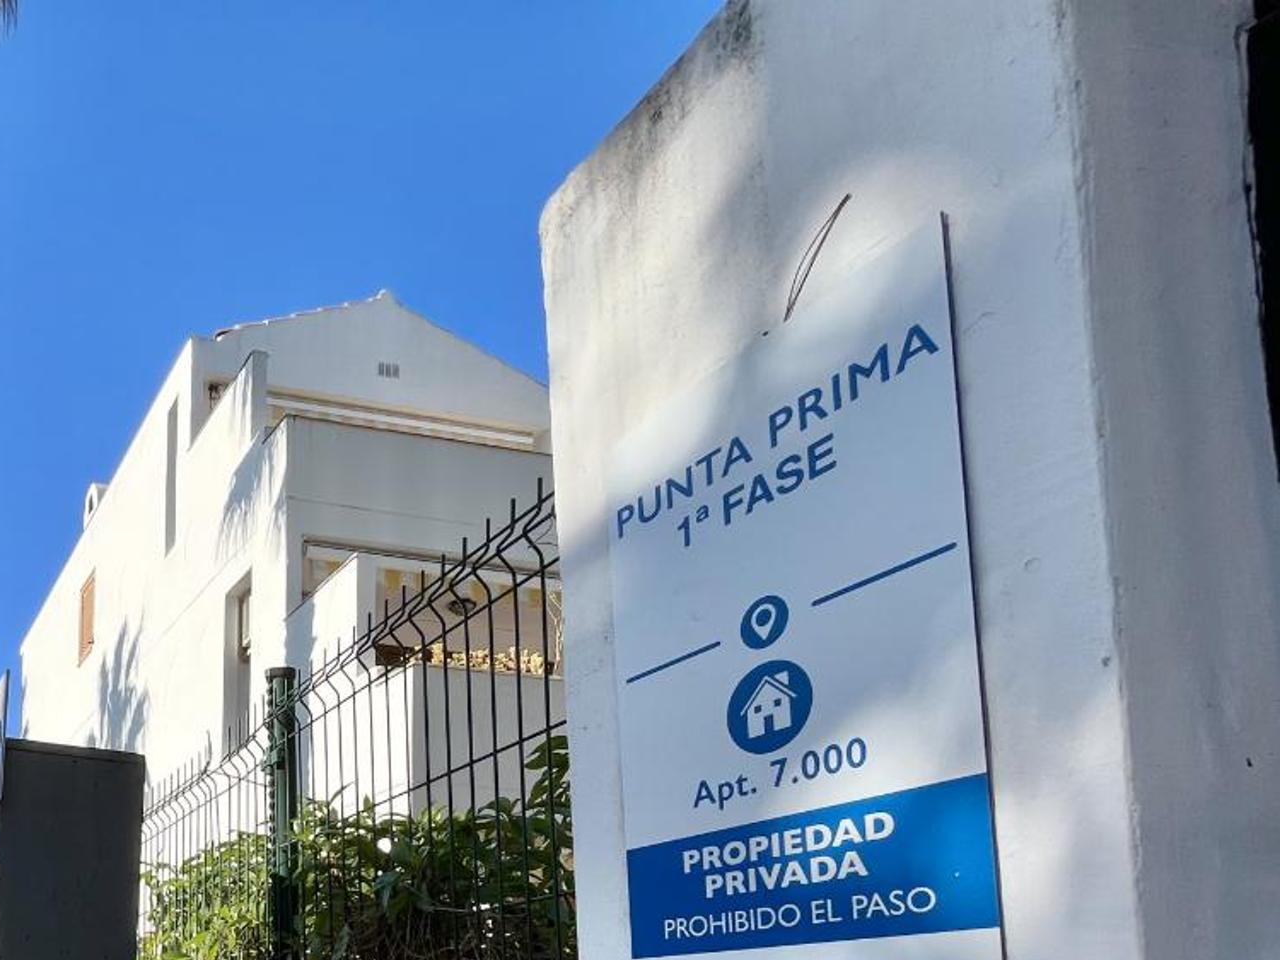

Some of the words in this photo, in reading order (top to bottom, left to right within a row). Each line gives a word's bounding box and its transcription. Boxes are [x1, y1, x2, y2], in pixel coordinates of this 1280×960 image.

[616, 436, 753, 539] PUNTA
[768, 323, 940, 447] PRIMA
[722, 433, 838, 526] FASE
[693, 774, 757, 811] Apt.
[770, 737, 867, 788] 7.000
[682, 811, 896, 874] PROPIEDAD
[705, 850, 868, 899] PRIVADA
[664, 903, 801, 940] PROHIBIDO
[811, 899, 842, 924] EL
[852, 886, 937, 920] PASO
